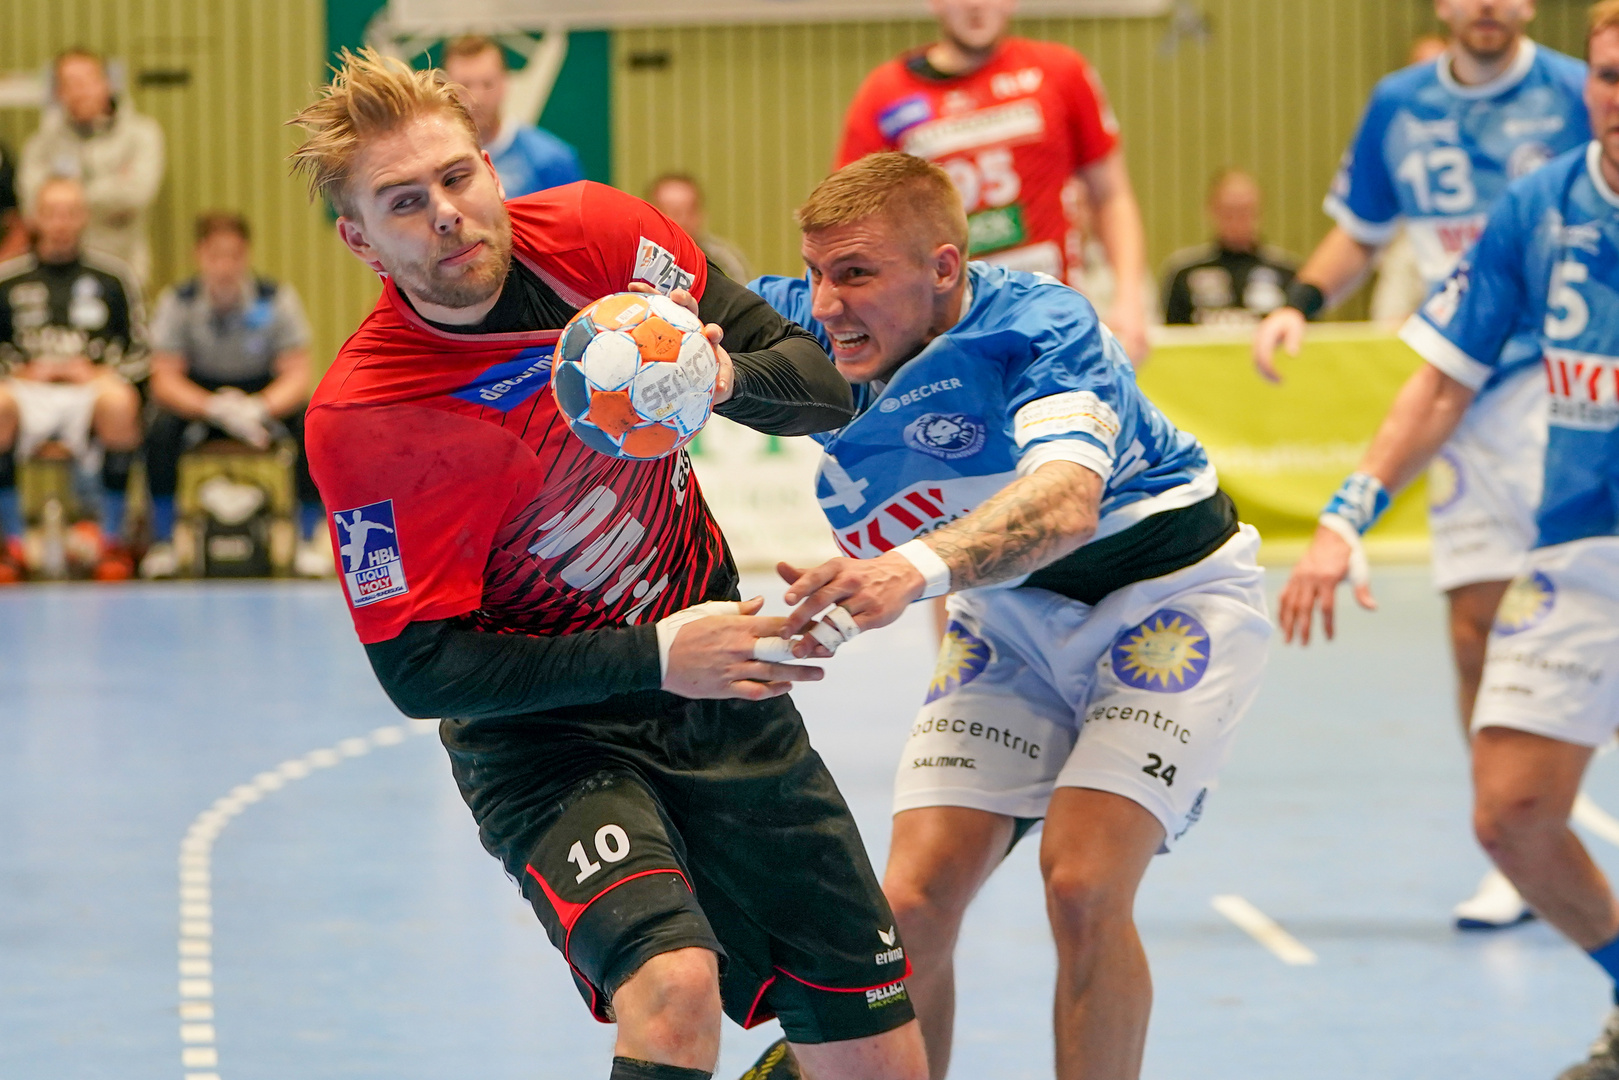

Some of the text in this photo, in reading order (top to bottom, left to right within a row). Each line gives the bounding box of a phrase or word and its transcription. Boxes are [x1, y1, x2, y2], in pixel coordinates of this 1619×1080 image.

[1398, 146, 1476, 214] 13
[1544, 260, 1590, 341] 5
[641, 342, 714, 412] SELECT
[900, 377, 963, 406] BECKER
[367, 546, 400, 567] HBL
[356, 566, 389, 584] LIQUI
[360, 577, 392, 596] MOLY
[1142, 752, 1178, 787] 24
[567, 823, 631, 885] 10
[875, 946, 903, 965] erima
